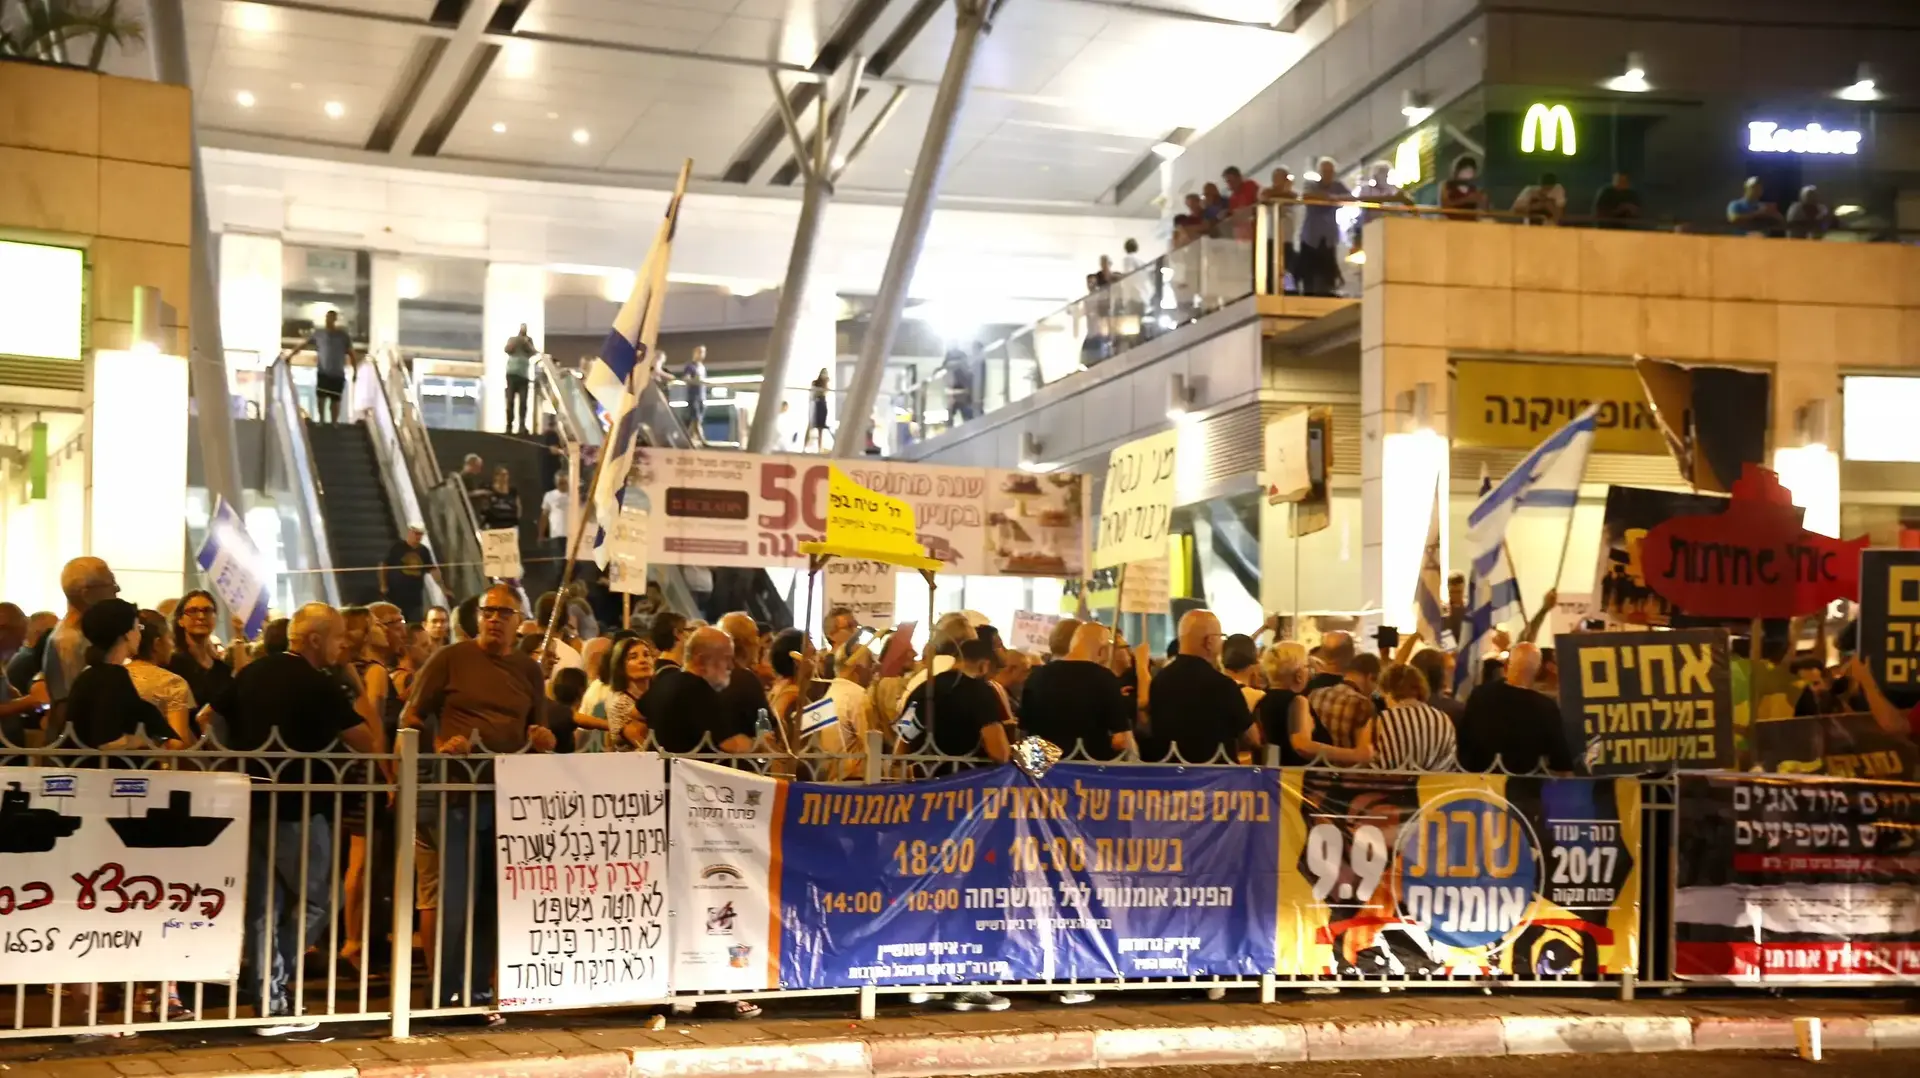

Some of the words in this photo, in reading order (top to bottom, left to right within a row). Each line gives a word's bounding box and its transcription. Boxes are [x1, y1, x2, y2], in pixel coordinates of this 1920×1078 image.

[1747, 121, 1862, 155] Kosher
[937, 475, 985, 498] שנה
[915, 502, 981, 532] בקניון
[1579, 643, 1715, 698] אחים
[1583, 698, 1716, 735] במלחמה
[1590, 734, 1716, 767] במושחתי
[689, 806, 723, 821] תקוה
[727, 807, 756, 820] פתח
[798, 792, 915, 825] אומנויות
[982, 787, 1068, 821] אומנים
[1075, 779, 1110, 821] של
[1117, 789, 1205, 822] פתוחים
[1212, 790, 1271, 822] בתים
[1733, 786, 1849, 813] מודאגים
[598, 823, 620, 861] לך
[893, 838, 975, 876] 18:00
[1008, 836, 1086, 872] 10:00
[1094, 838, 1183, 872] בשעות
[1409, 810, 1521, 878] שבת
[1306, 823, 1388, 901] 9.9
[1551, 846, 1619, 884] 2017
[564, 864, 599, 894] צדק
[1059, 881, 1091, 907] לכל
[533, 896, 593, 924] משפט
[641, 881, 663, 917] לא
[823, 890, 882, 913] 14:00
[905, 888, 960, 912] 10:00
[965, 886, 1053, 909] המשפחה
[1096, 885, 1168, 908] אומנותי
[1173, 886, 1233, 907] הפנינג
[1408, 884, 1526, 933] אומנים
[1552, 888, 1586, 906] תקוה
[1587, 888, 1616, 902] פתח
[69, 930, 142, 958] מושחתים
[529, 928, 577, 957] פנים
[639, 921, 661, 949] לא
[508, 958, 563, 989] שוחד
[574, 958, 616, 990] תיקח
[621, 953, 654, 981] ולא
